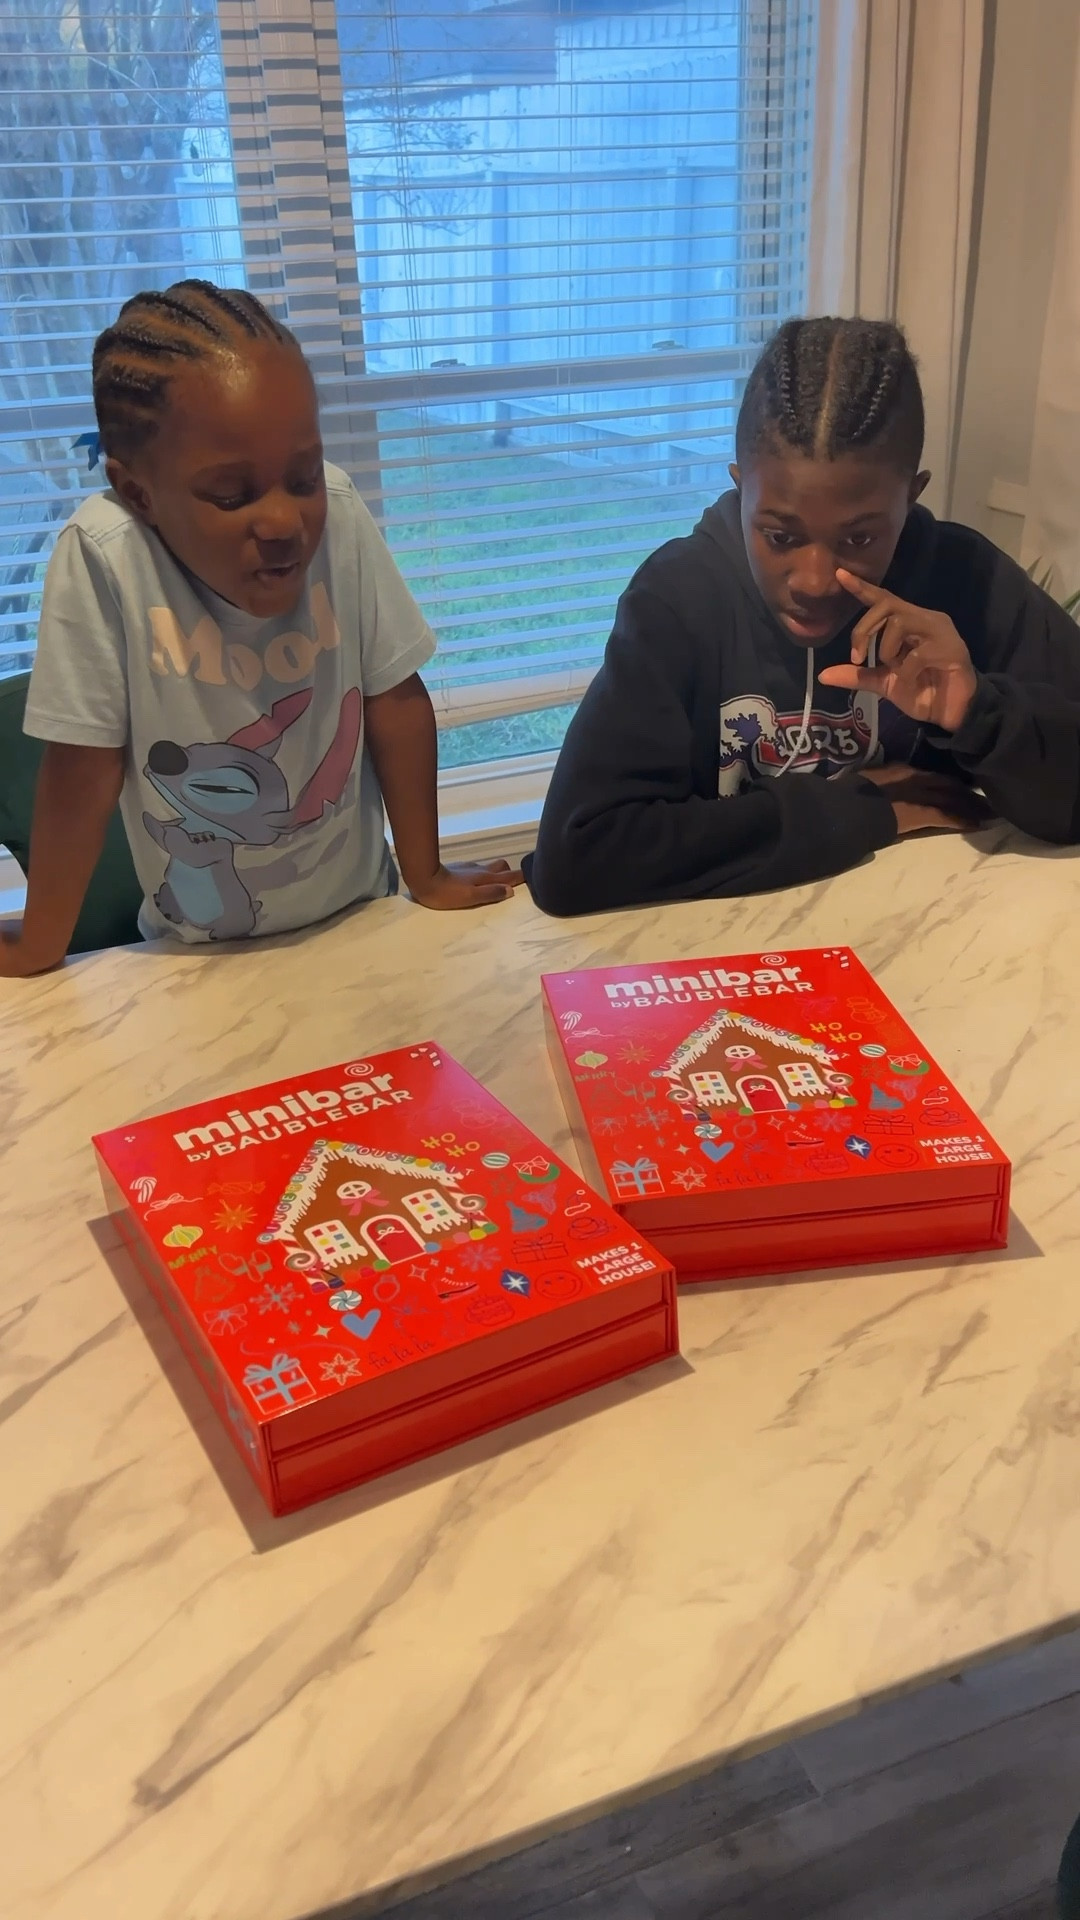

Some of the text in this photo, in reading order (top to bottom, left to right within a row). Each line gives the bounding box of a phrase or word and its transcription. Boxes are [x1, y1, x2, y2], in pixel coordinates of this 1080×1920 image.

[148, 581, 341, 691] Mood
[604, 966, 802, 998] minibar
[611, 981, 815, 1009] by BAUBLEBAR
[809, 1022, 843, 1034] HO
[829, 1032, 863, 1044] HO
[173, 1072, 394, 1151] minibar
[186, 1089, 413, 1163] by BAUBLEBAR
[420, 1132, 456, 1149] HO
[445, 1141, 480, 1158] HO
[919, 1135, 986, 1148] MAKES 1
[933, 1144, 984, 1155] LARGE
[343, 1142, 415, 1164] HOUSE
[935, 1152, 994, 1164] HOUSE!
[168, 1244, 219, 1270] MERRY
[576, 1241, 643, 1269] MAKES 1
[592, 1252, 644, 1275] LARGE
[598, 1260, 657, 1286] HOUSE!
